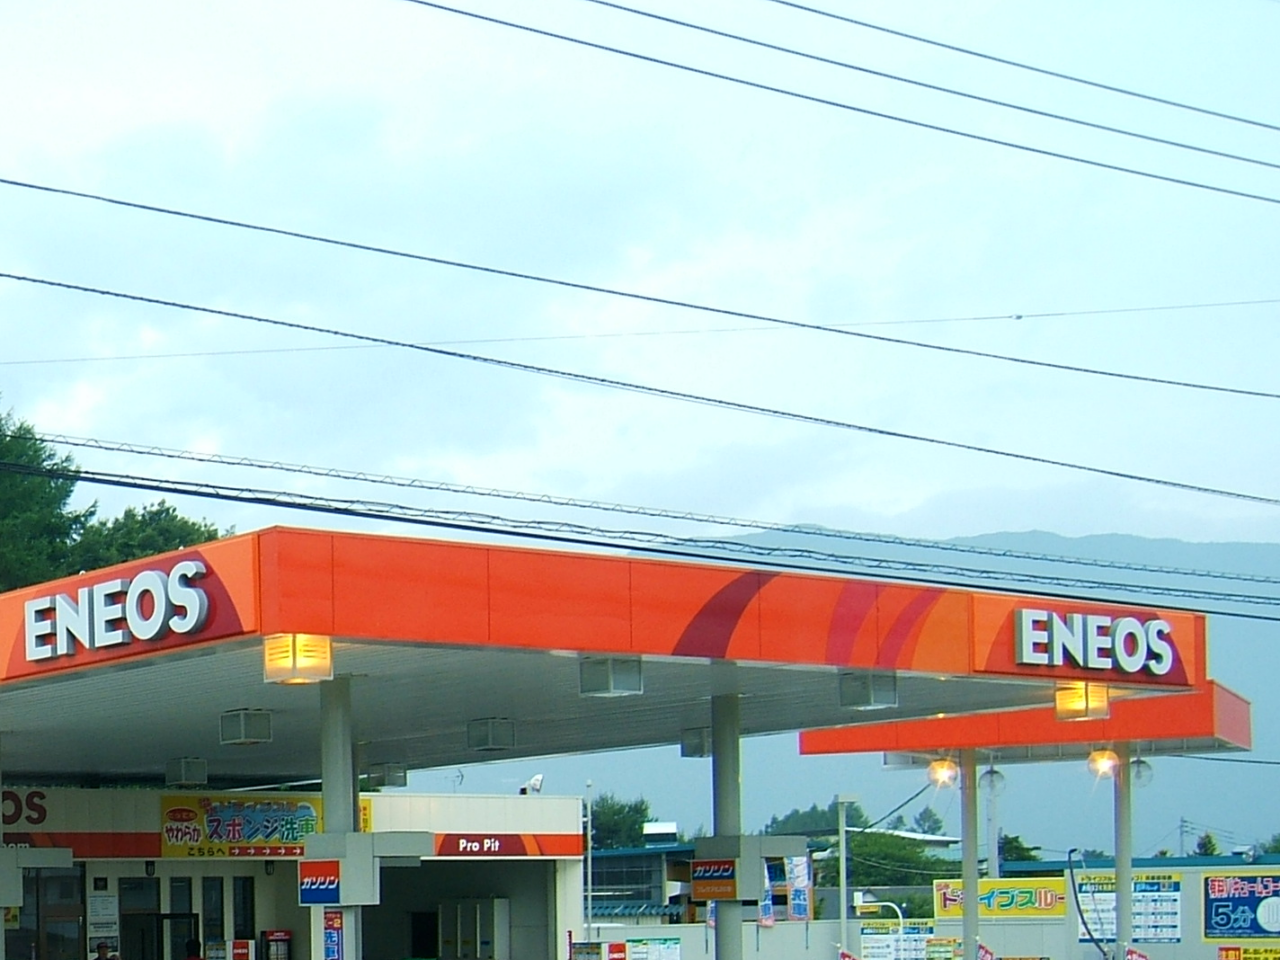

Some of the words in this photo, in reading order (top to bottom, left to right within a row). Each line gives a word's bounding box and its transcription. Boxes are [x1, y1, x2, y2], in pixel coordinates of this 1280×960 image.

[24, 560, 208, 661] ENEOS
[1016, 608, 1173, 675] ENEOS
[206, 816, 317, 843] スポンジ洗車
[459, 839, 480, 852] Pro
[483, 838, 500, 851] Pit
[301, 876, 339, 889] ガソリン
[941, 886, 1065, 910] ドイブスルー
[1211, 902, 1255, 929] 5分
